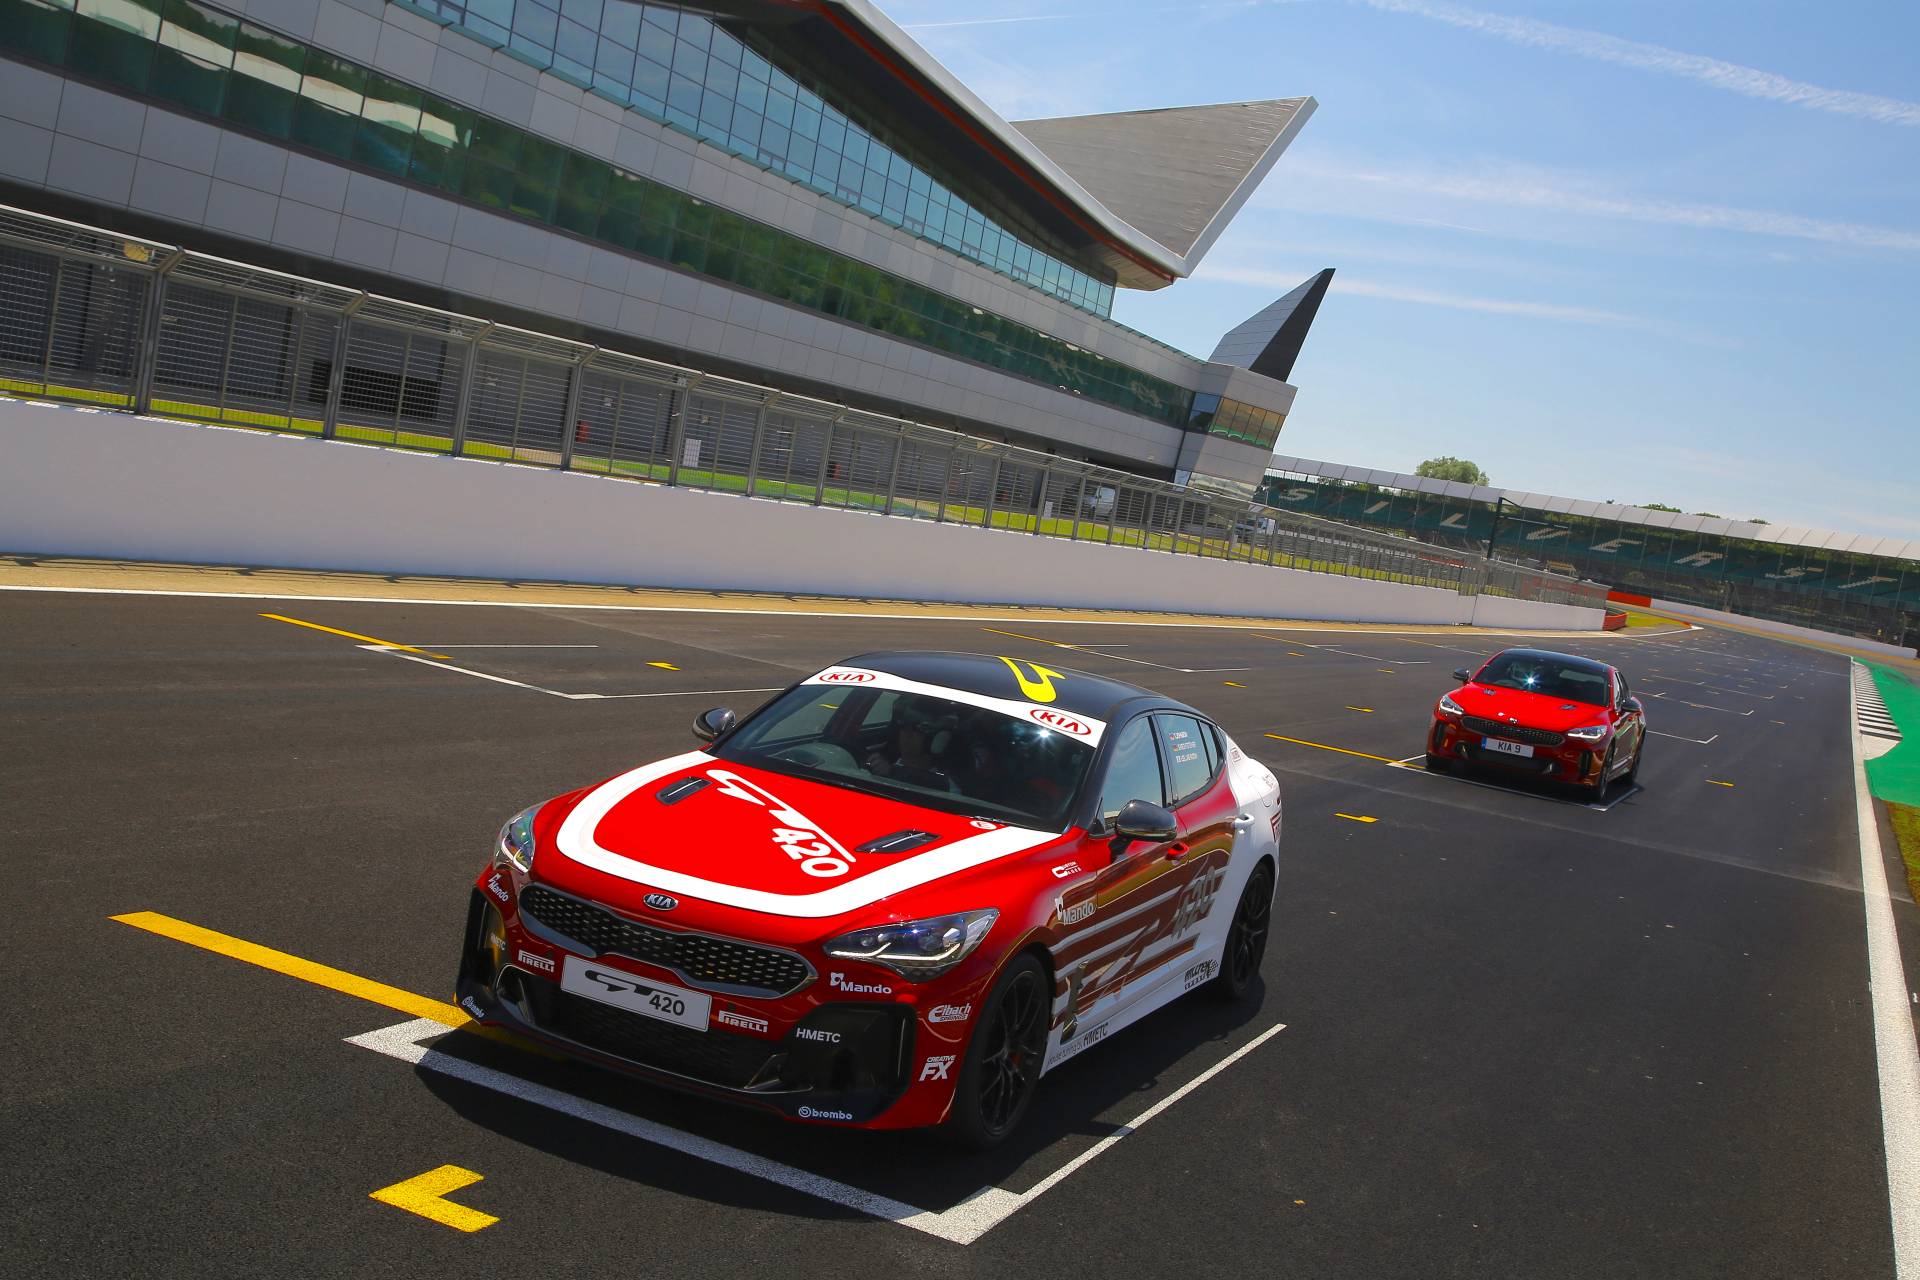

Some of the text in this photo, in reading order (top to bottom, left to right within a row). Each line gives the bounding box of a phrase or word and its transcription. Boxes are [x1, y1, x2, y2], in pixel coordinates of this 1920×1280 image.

[828, 673, 865, 682] KIA
[1039, 711, 1079, 732] KIA
[1497, 741, 1521, 754] KIA 9
[771, 827, 850, 878] 420
[647, 893, 672, 908] KIA
[1063, 901, 1095, 925] Mando
[518, 950, 555, 973] PIRELLI
[840, 980, 893, 995] Mando
[648, 994, 686, 1016] 420
[928, 1002, 972, 1023] Eibach
[717, 1010, 769, 1033] PIRELLI
[796, 1027, 842, 1043] HMETC
[918, 1061, 955, 1082] FX
[812, 1108, 853, 1120] brembo
